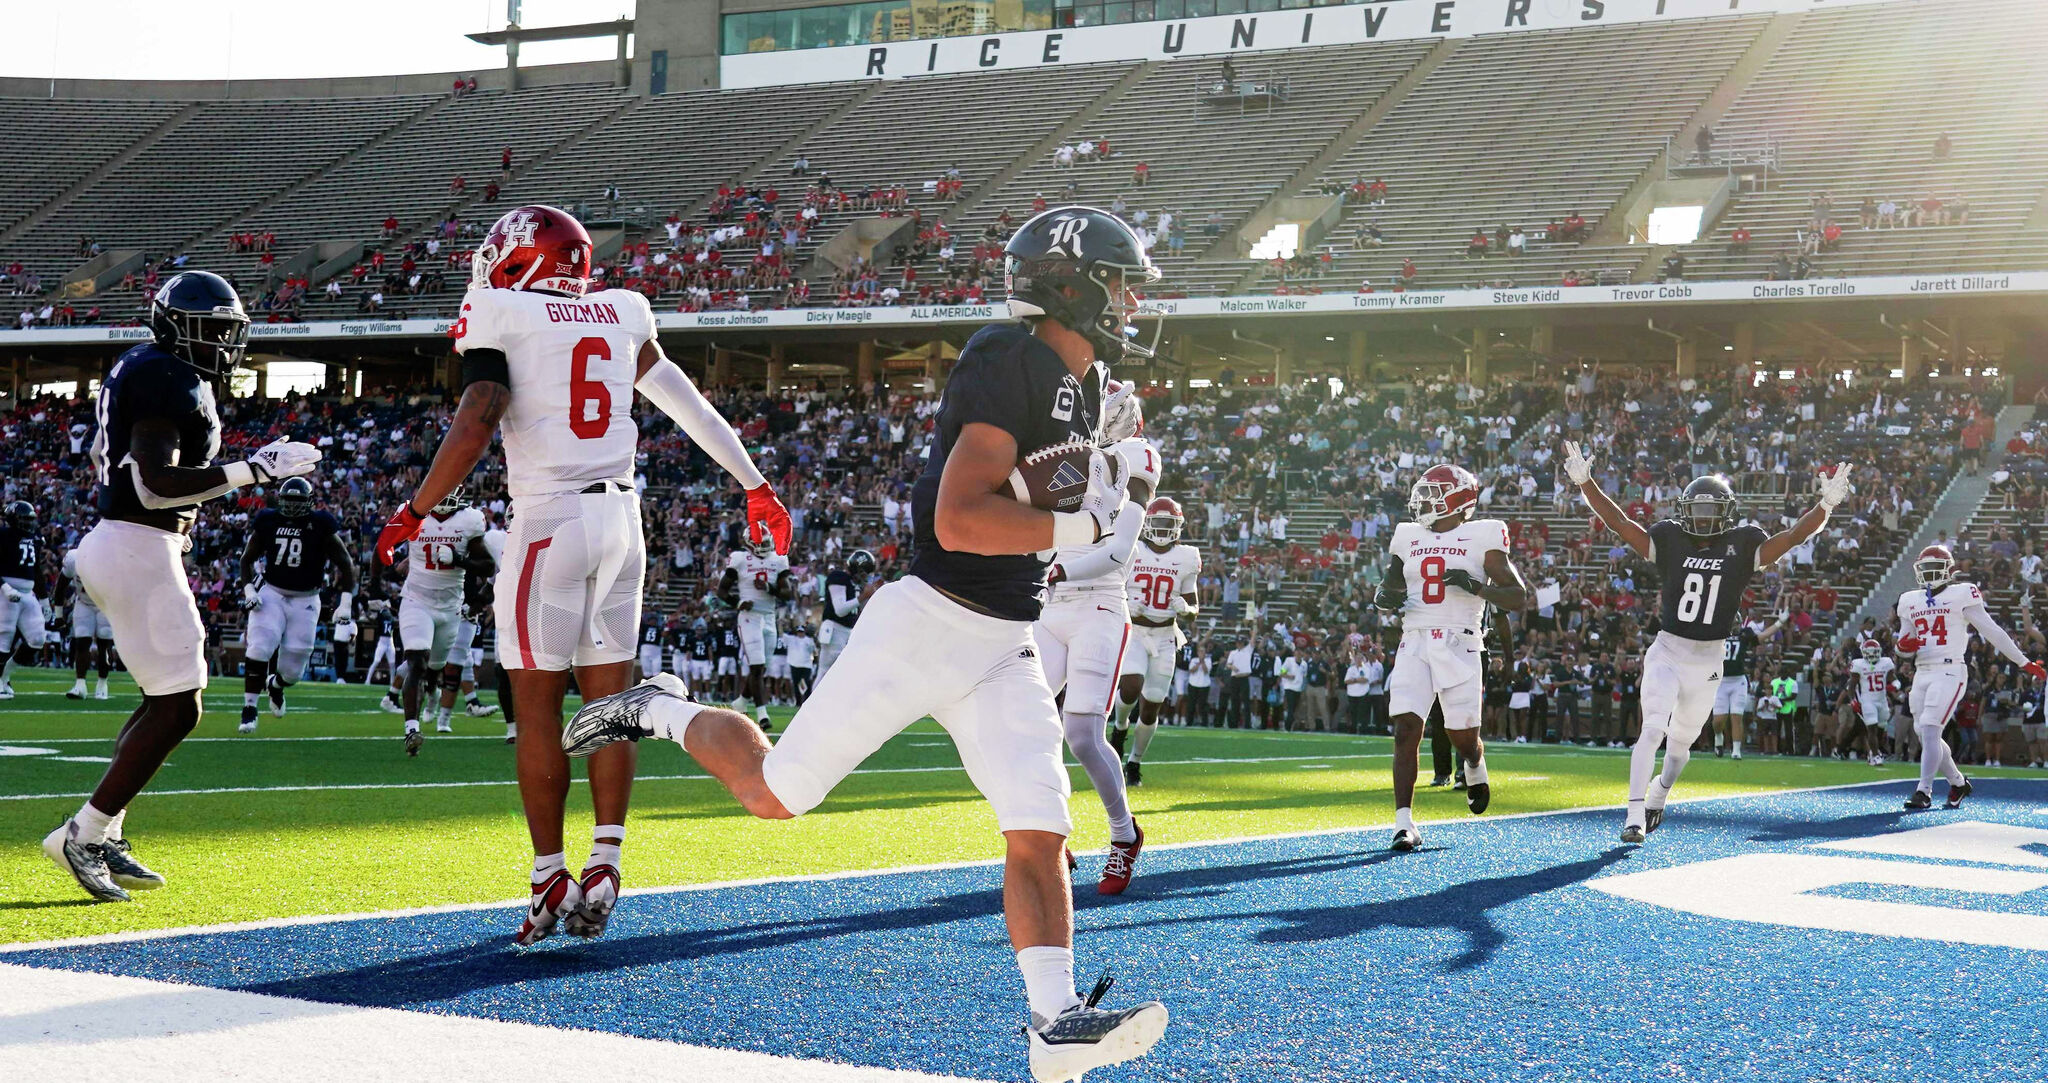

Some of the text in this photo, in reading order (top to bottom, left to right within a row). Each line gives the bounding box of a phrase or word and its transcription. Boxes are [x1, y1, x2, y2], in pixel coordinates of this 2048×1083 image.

[866, 0, 1824, 76] RICE UNIVERS
[1753, 282, 1855, 297] Charles Torello
[1910, 276, 2009, 291] Jarett Dillard
[1493, 289, 1560, 304] Steve Kidd
[1612, 286, 1692, 300] Trevor Cobb
[1220, 298, 1307, 312] Malcom Walker
[1353, 294, 1445, 309] Tommy Kramer
[546, 303, 620, 325] GUZMAN
[697, 314, 768, 325] Kosse Johnson
[806, 310, 872, 323] Dicky Maegle
[910, 307, 992, 318] ALL AMERICANS
[109, 328, 151, 339] Bill Wallace
[250, 325, 310, 335] Weldon Humble
[340, 323, 402, 335] Froggy Williams
[569, 337, 612, 439] 6
[1057, 391, 1073, 413] C
[1144, 448, 1155, 474] 1
[276, 527, 302, 536] RICE
[274, 538, 303, 568] 78
[1410, 546, 1467, 558] HOUSTON
[1133, 565, 1179, 576] HOUSTON
[1682, 556, 1724, 571] RICE
[1420, 556, 1446, 605] 8
[1134, 573, 1174, 610] 30
[1677, 572, 1723, 625] 81
[1911, 608, 1951, 619] HOUSTON
[1915, 615, 1948, 647] 24
[1723, 641, 1741, 661] 87
[1867, 674, 1885, 692] 15
